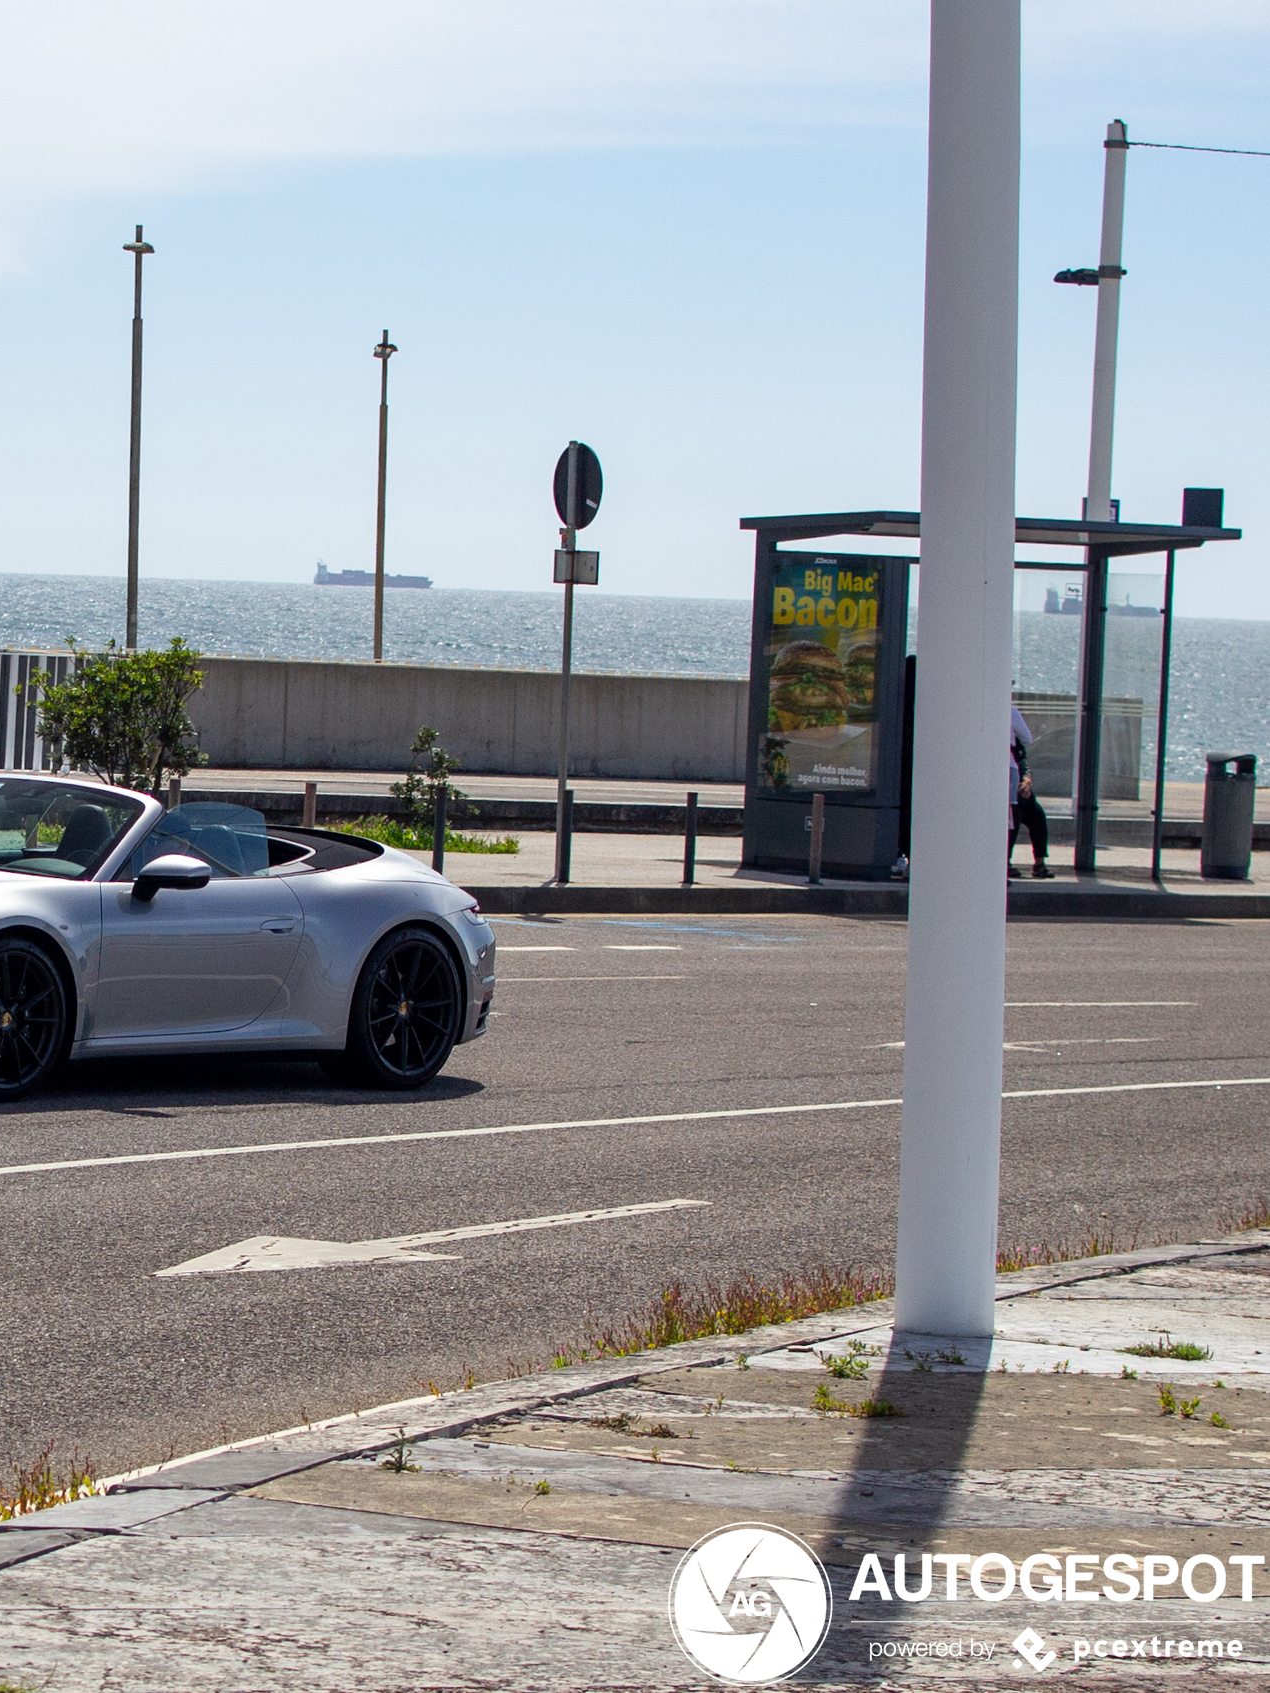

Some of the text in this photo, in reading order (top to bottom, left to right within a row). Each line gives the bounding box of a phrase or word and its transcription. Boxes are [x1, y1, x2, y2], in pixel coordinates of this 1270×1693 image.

[804, 568, 833, 597] Big
[773, 586, 878, 629] Bacon
[797, 774, 867, 787] agora com bacon.
[812, 763, 868, 779] Ainda melhor,
